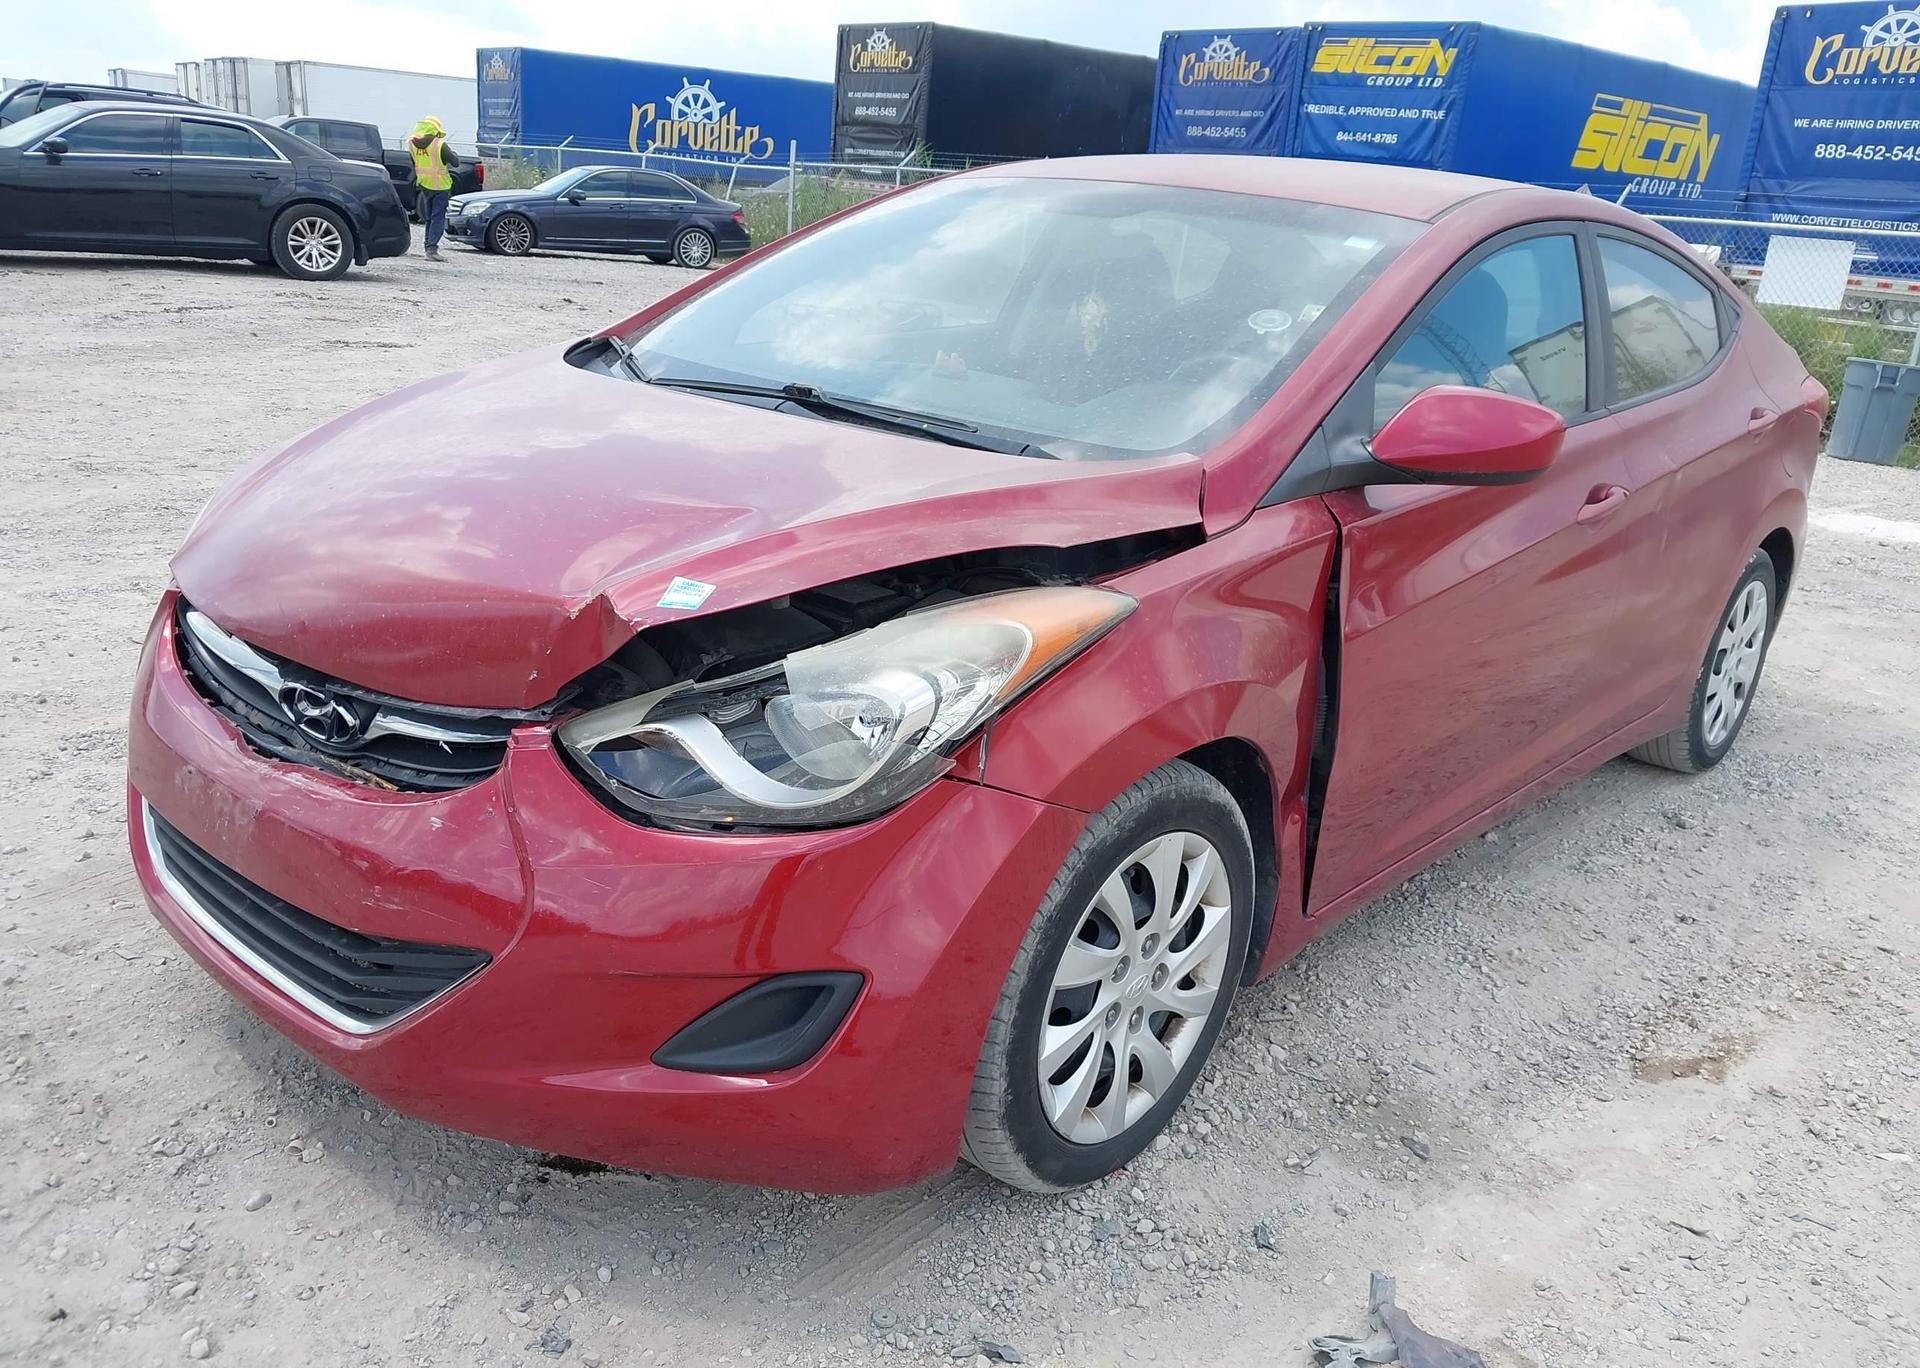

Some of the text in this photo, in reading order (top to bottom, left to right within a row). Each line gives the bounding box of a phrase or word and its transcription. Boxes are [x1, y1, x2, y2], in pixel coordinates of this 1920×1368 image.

[850, 40, 913, 72] Corvette
[1179, 50, 1270, 86] Corvette
[1366, 75, 1446, 88] GROUP LTD.
[1833, 77, 1916, 85] LOGISTICS
[855, 106, 897, 117] 888-452-5455
[1348, 106, 1398, 118] APPROVED
[1398, 109, 1419, 119] AND
[1421, 109, 1447, 120] TRUE
[1794, 118, 1920, 130] WE ARE HIRING DRIVER
[629, 102, 774, 160] Corvette
[1187, 126, 1247, 138] 888-452-5455
[1336, 131, 1398, 144] 844-641-8785
[1631, 177, 1703, 199] GROUP LTD.
